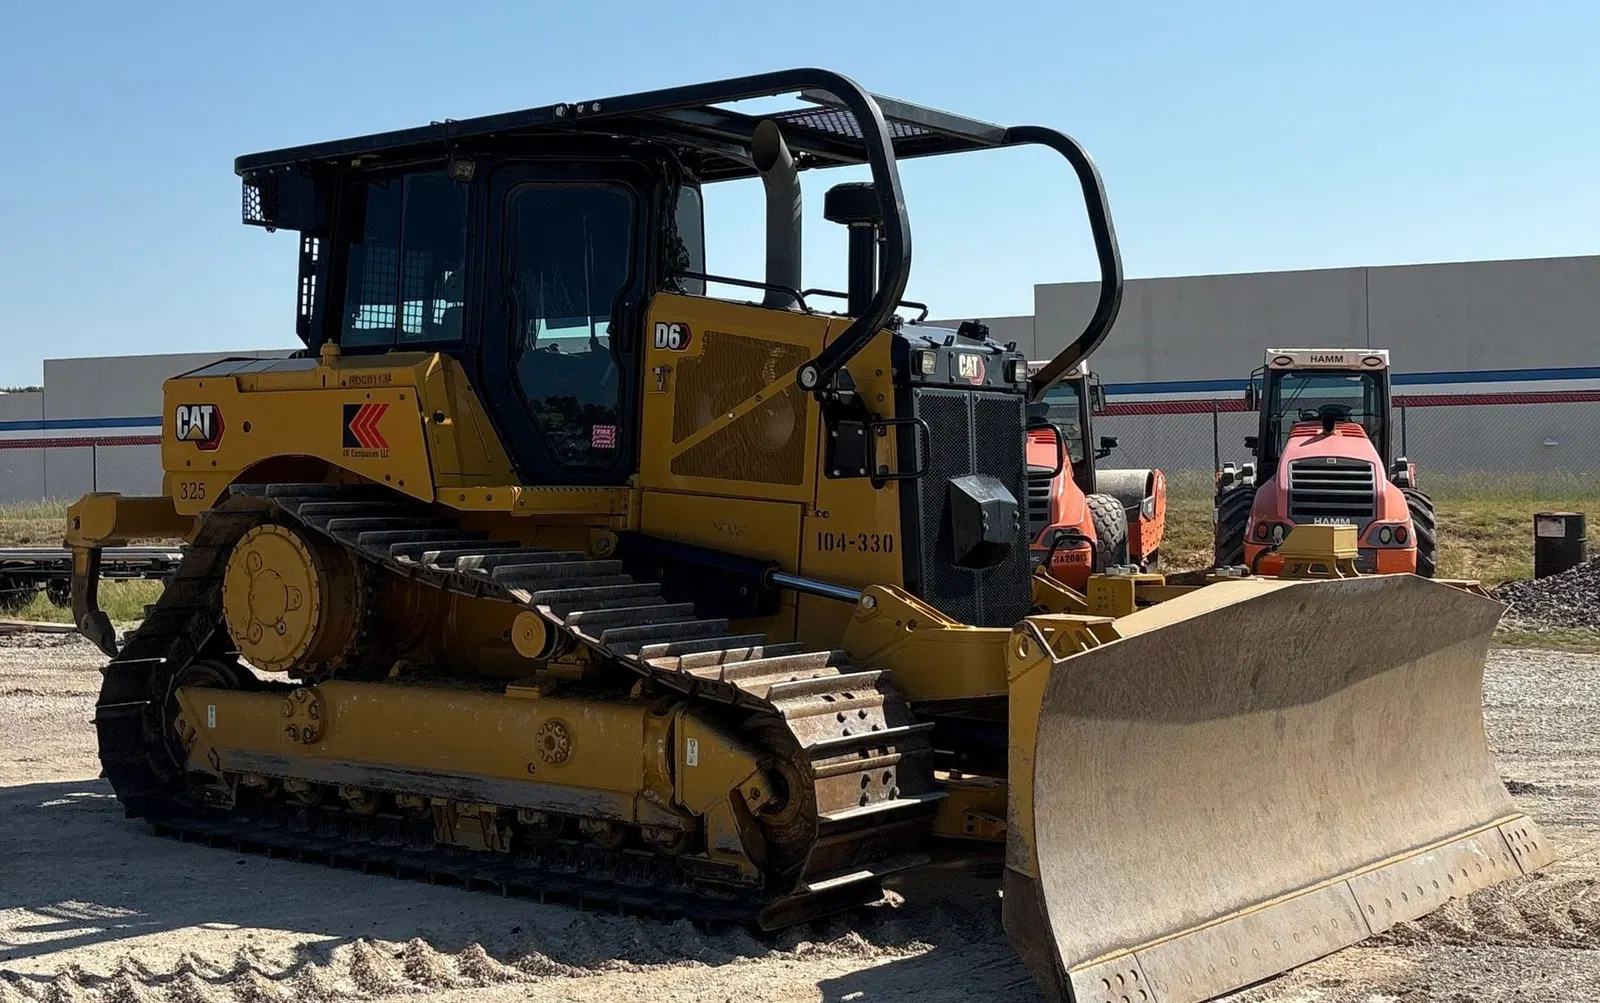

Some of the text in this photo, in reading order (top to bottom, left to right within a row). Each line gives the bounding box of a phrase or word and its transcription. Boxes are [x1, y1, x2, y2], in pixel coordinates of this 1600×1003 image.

[655, 323, 681, 349] D6
[958, 354, 979, 377] CAT
[1310, 355, 1344, 363] HAMM
[176, 404, 213, 441] CAT
[180, 482, 206, 500] 325
[1313, 517, 1351, 525] HAMM
[817, 531, 894, 555] 104-330
